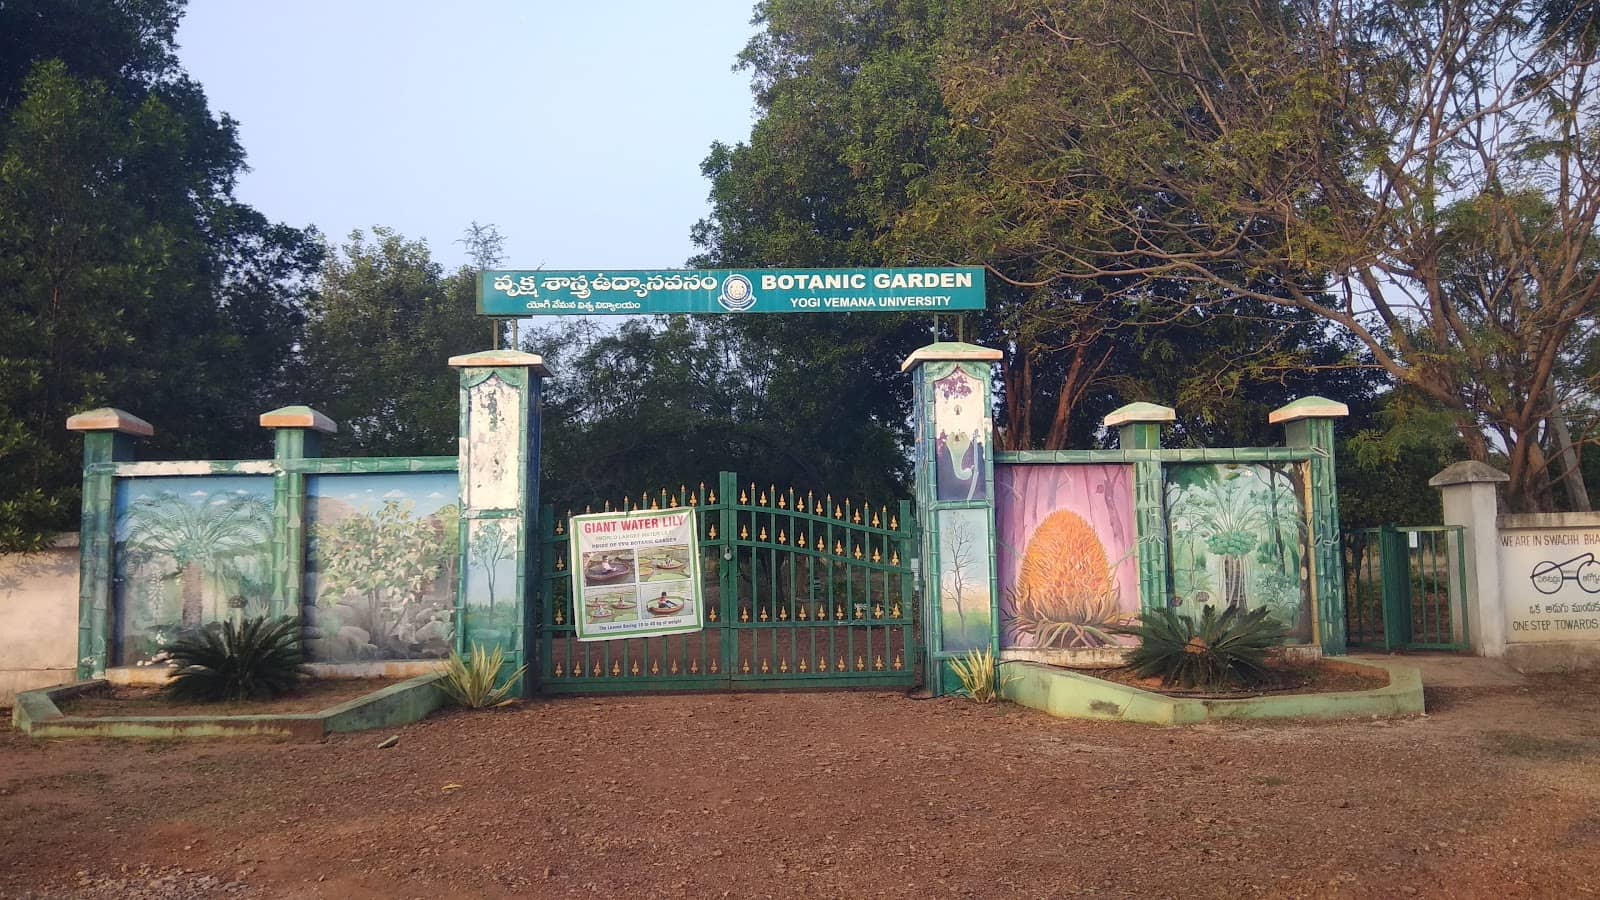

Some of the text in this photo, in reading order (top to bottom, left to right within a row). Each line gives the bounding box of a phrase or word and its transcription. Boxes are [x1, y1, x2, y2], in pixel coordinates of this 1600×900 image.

[761, 272, 972, 290] BOTANIC GARDEN
[790, 295, 951, 308] YOGI VEMANA UNIVERSITY
[585, 515, 684, 533] GIANT WATER LILY
[1501, 536, 1513, 546] WE
[1516, 535, 1530, 546] ARE
[1533, 535, 1541, 546] IN
[1544, 534, 1579, 545] SWACHH
[1512, 618, 1599, 631] ONE STEP TOWARDS
